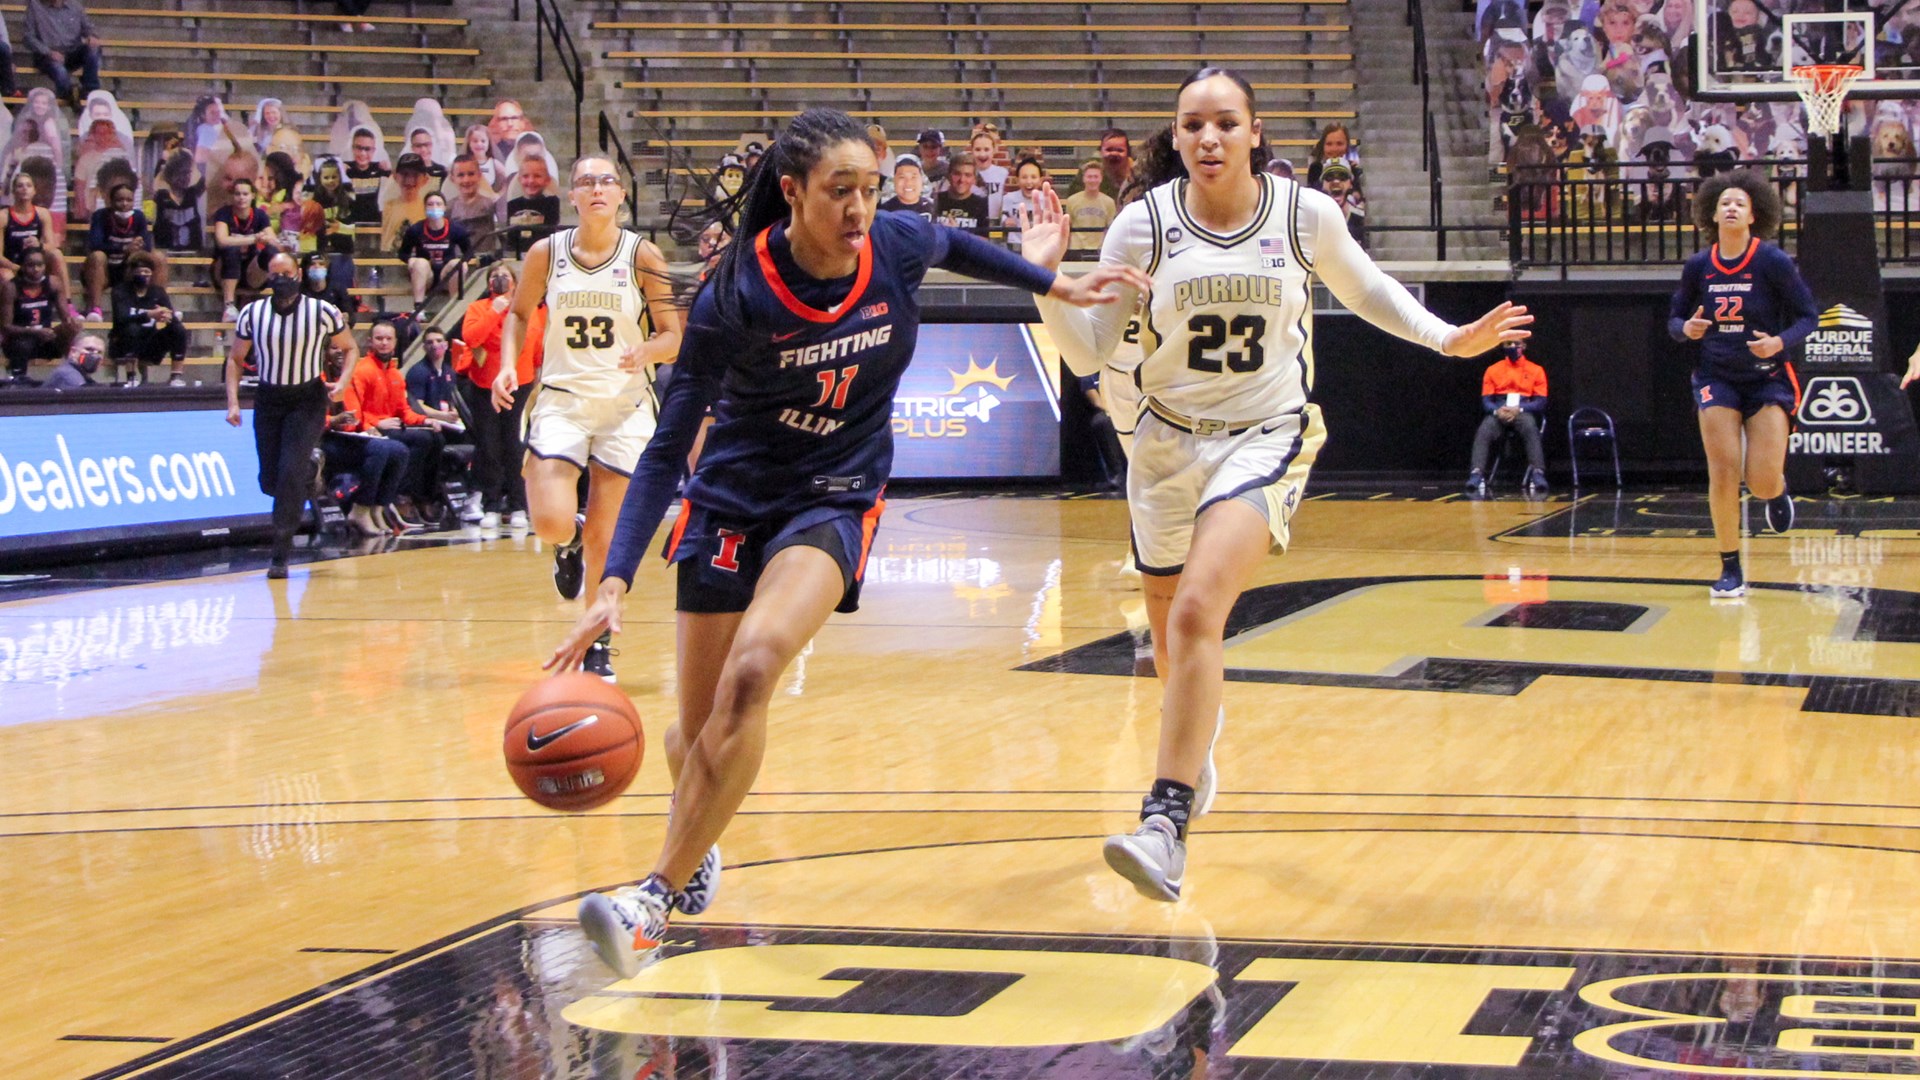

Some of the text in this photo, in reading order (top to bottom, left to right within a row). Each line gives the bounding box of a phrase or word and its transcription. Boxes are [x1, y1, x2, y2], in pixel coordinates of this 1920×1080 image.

[557, 291, 622, 312] PURDUE
[1174, 274, 1282, 311] PURDUE
[1708, 284, 1753, 292] FIGHTING
[1715, 296, 1744, 321] 22
[565, 316, 615, 349] 33
[779, 323, 893, 369] FIGHTING
[1188, 314, 1266, 373] 23
[1805, 344, 1873, 355] FEDERAL
[809, 363, 860, 409] 11
[778, 408, 846, 436] ILLIN
[890, 418, 967, 438] PLUS
